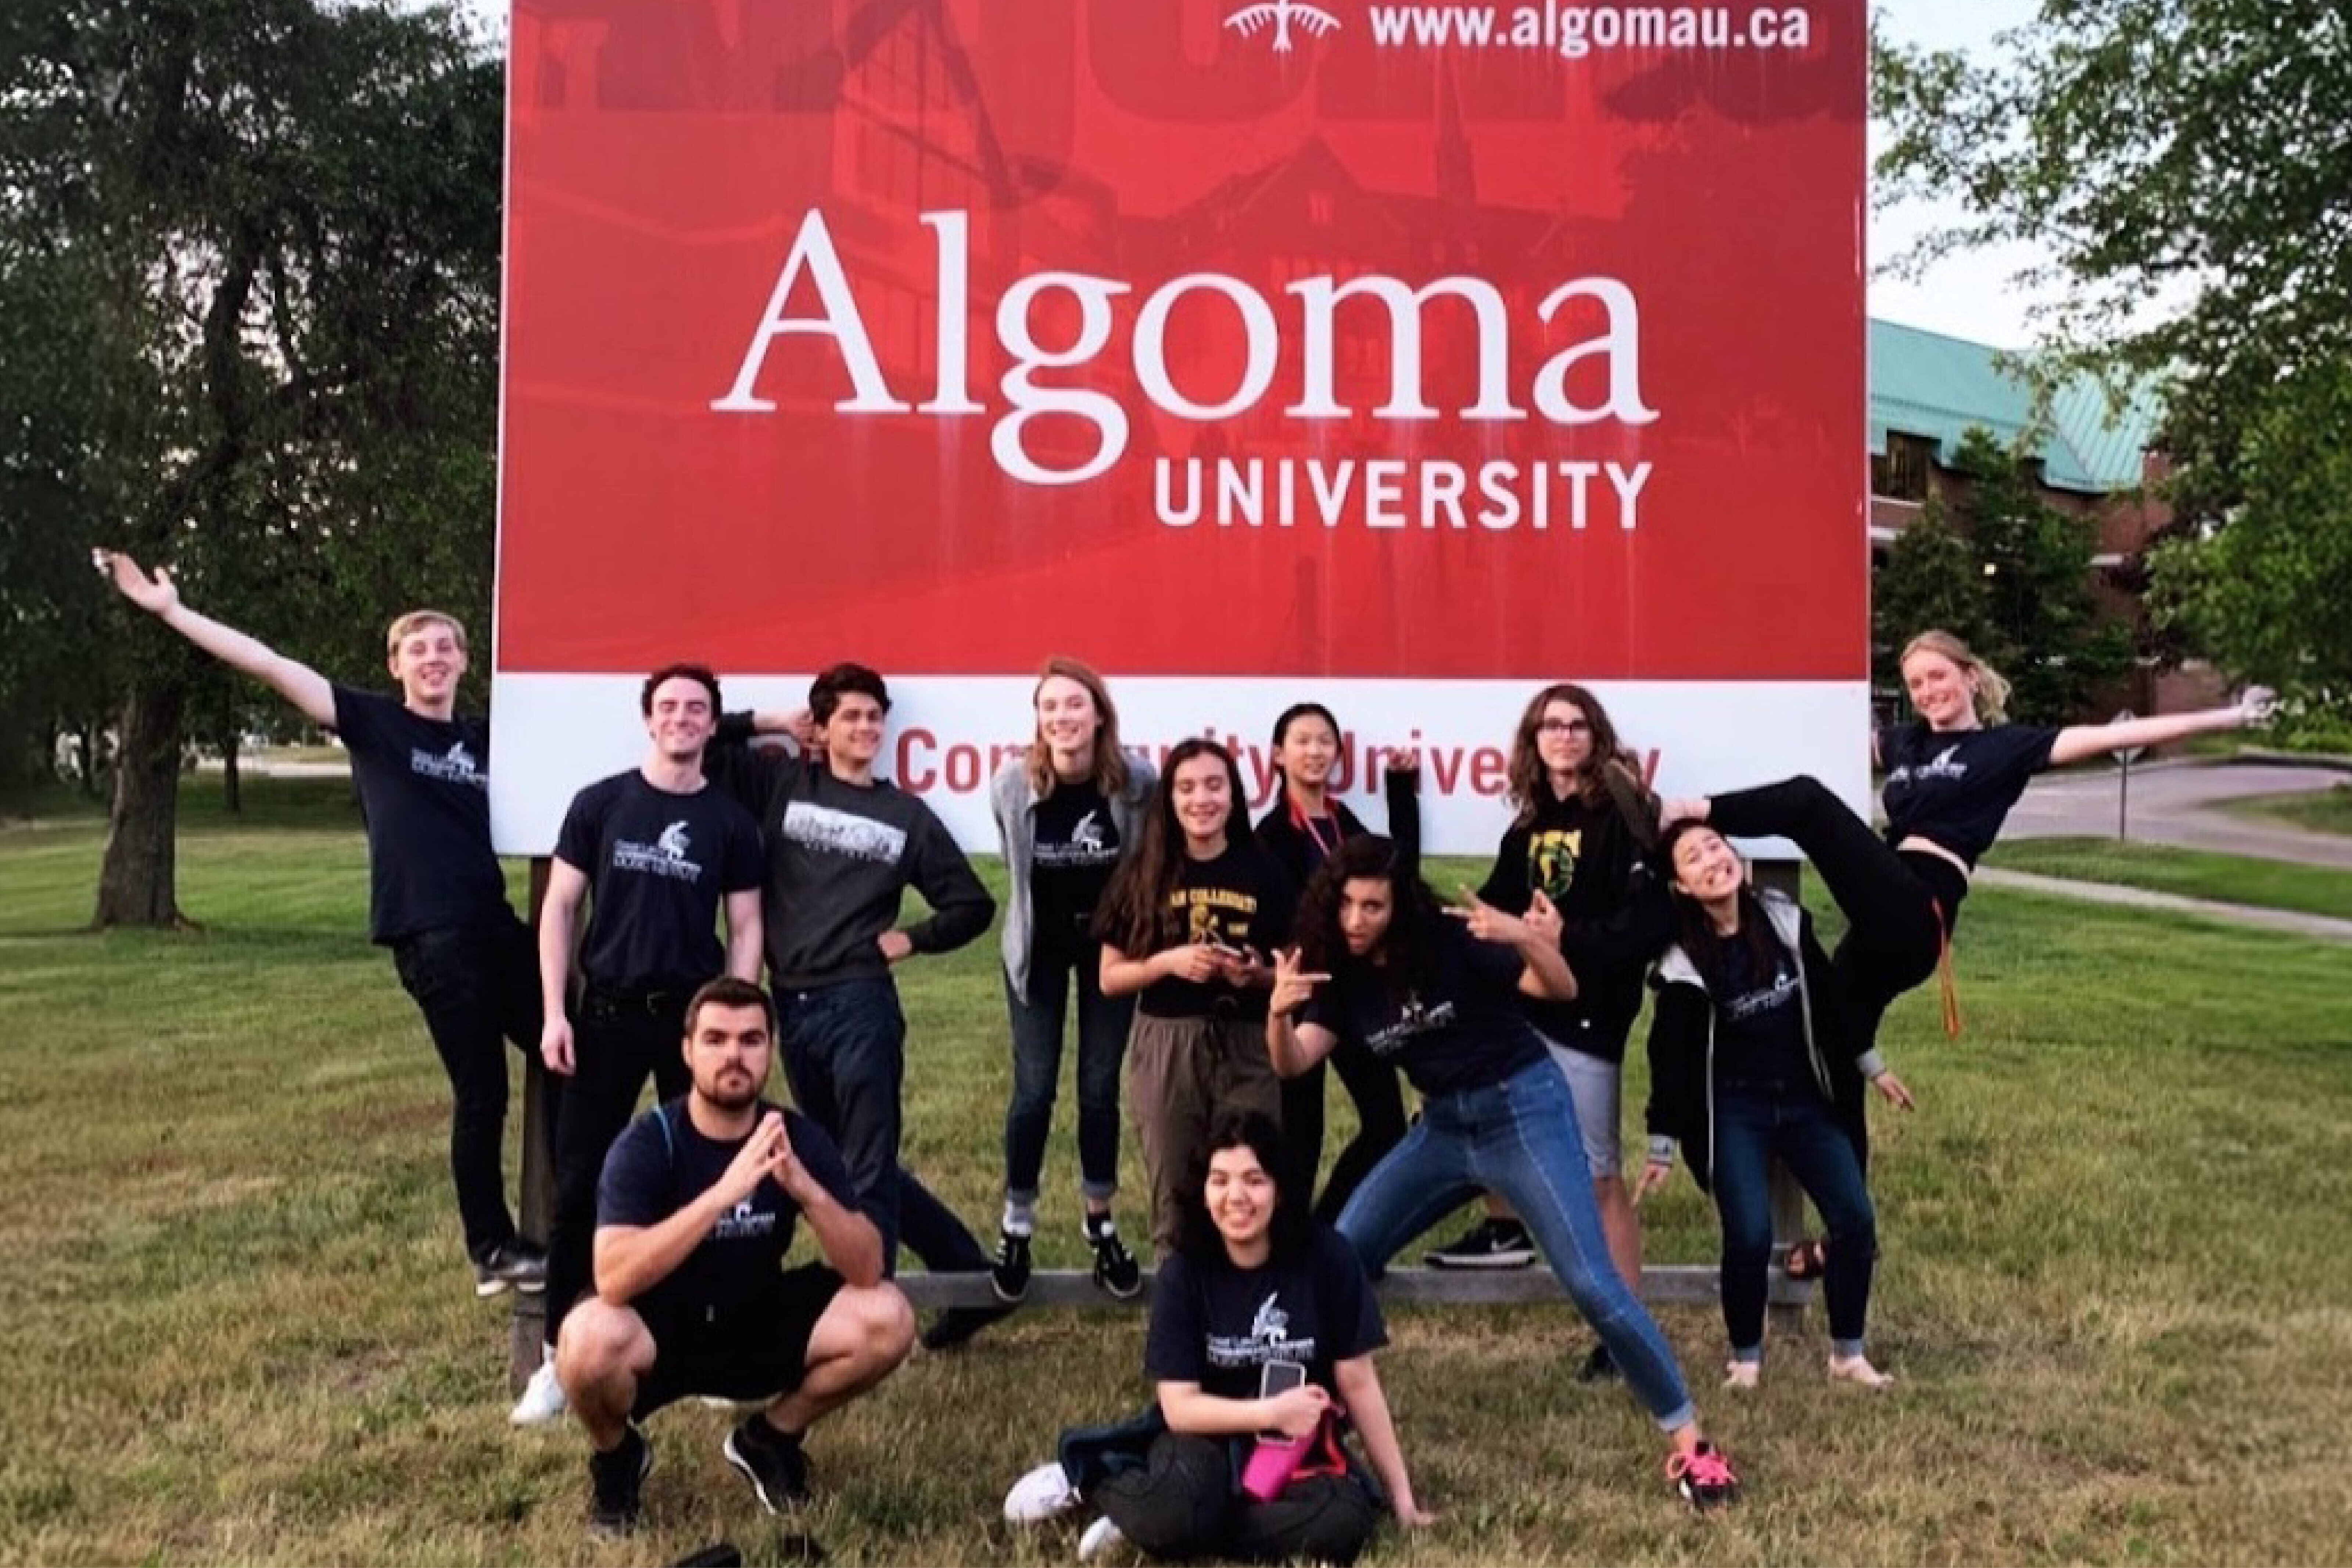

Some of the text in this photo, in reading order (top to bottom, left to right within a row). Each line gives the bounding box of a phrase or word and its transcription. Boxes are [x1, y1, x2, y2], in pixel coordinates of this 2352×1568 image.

[1370, 0, 1809, 58] www.algomau.ca
[710, 208, 1659, 485] Algoma
[1155, 457, 1653, 529] UNIVERSITY
[1324, 728, 1661, 796] Univey
